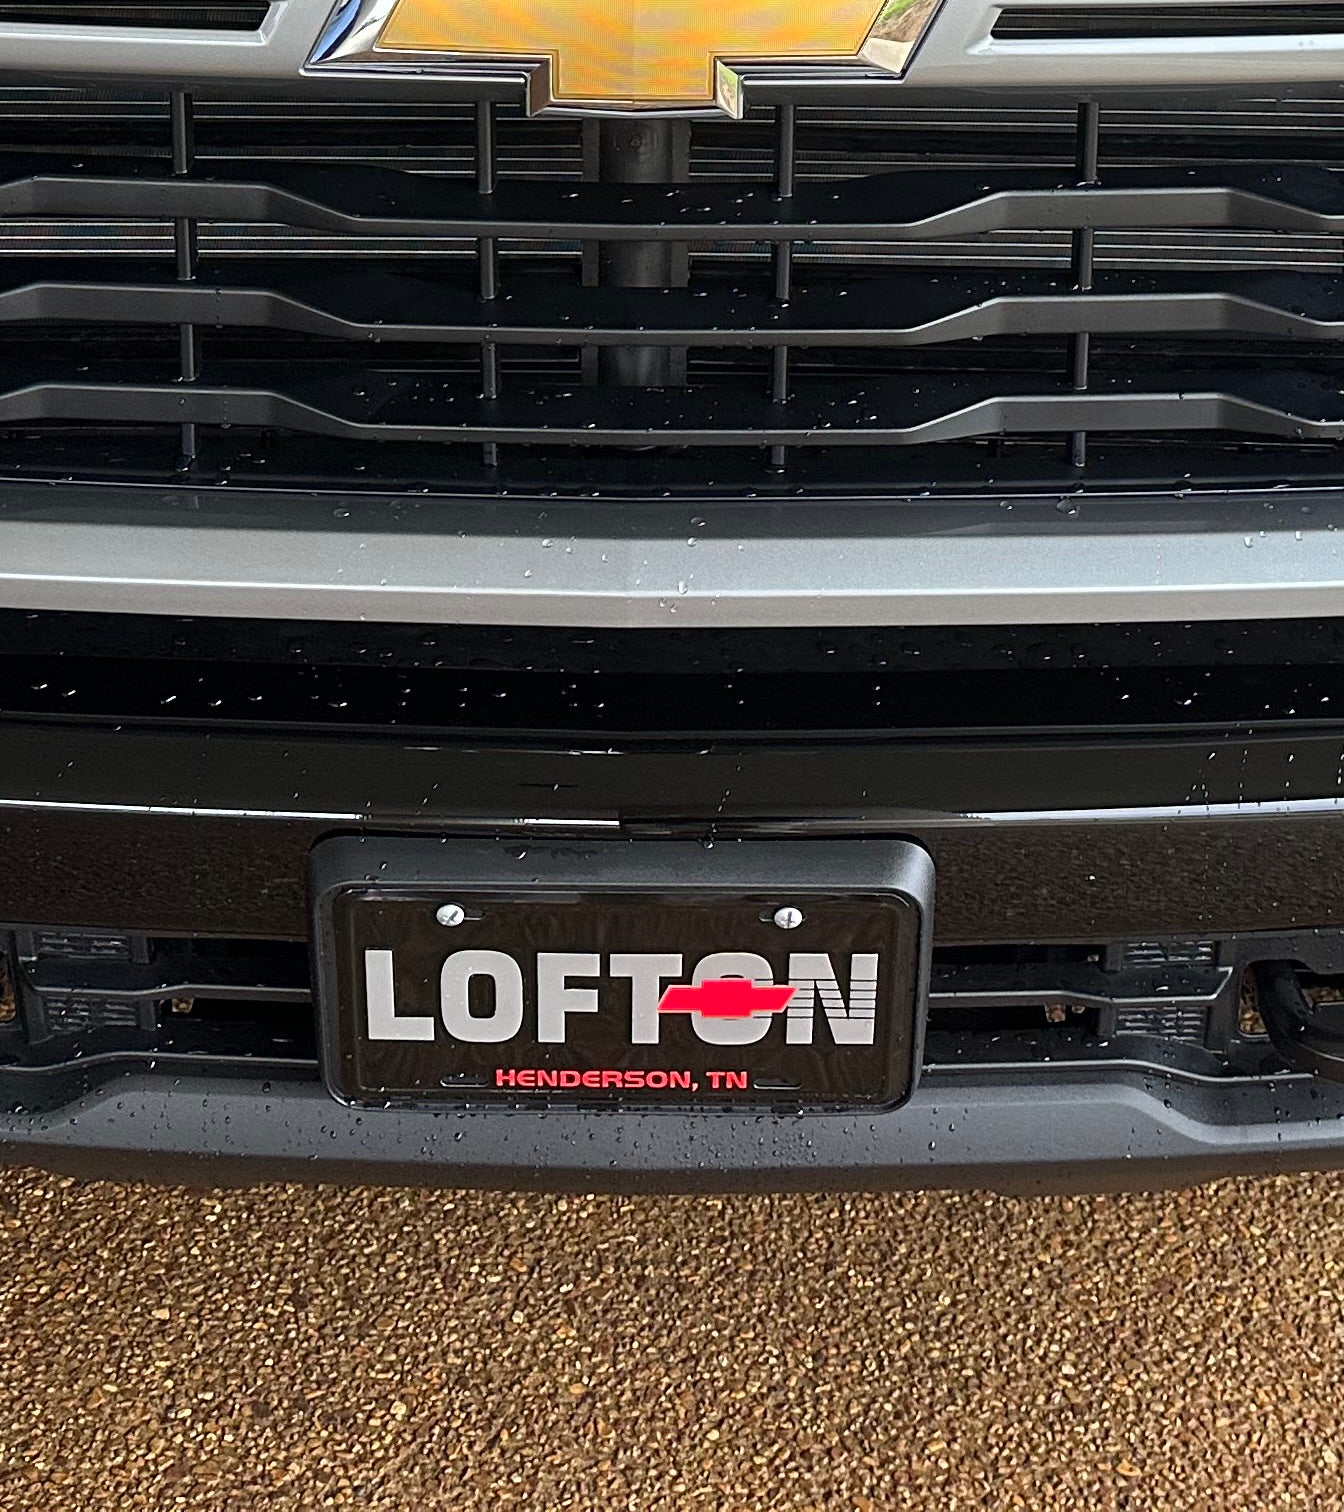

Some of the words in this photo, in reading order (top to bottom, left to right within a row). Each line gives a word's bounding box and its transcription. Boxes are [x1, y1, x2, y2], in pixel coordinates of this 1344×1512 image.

[364, 949, 880, 1046] LOFTON
[495, 1069, 699, 1092] HENDERSON,
[704, 1070, 749, 1089] TN
